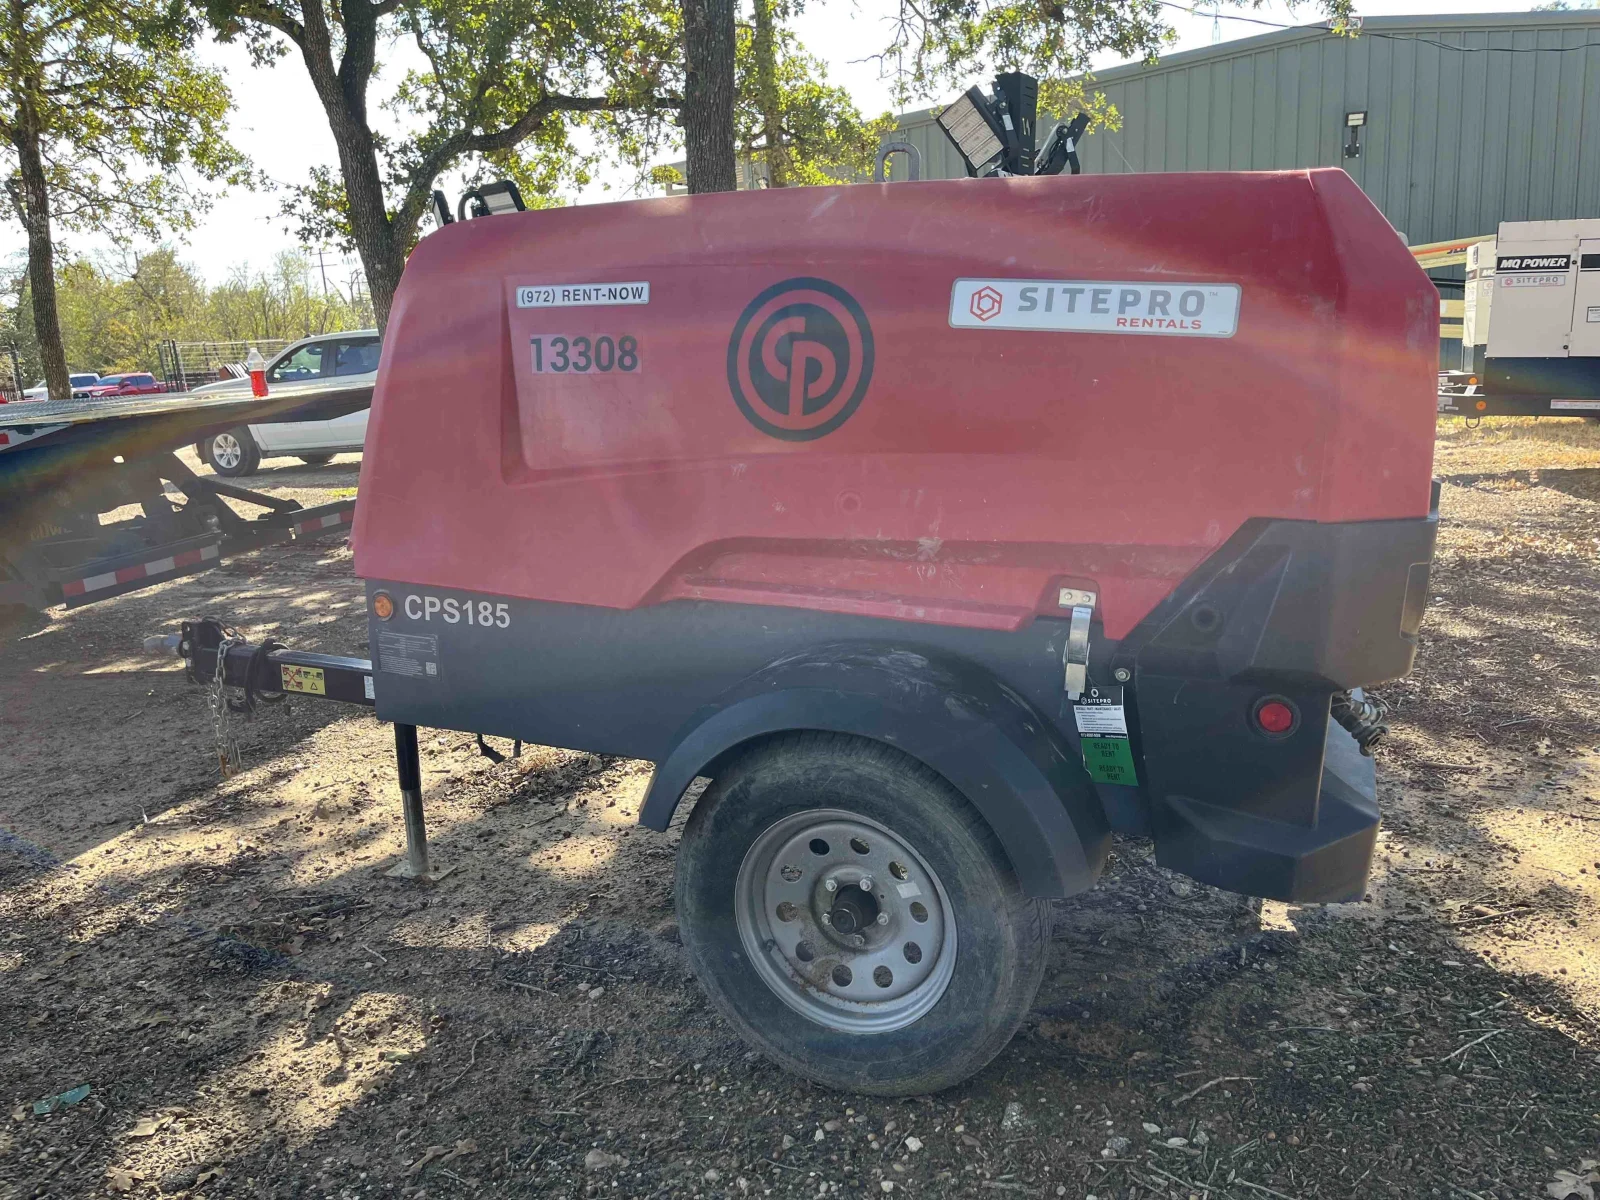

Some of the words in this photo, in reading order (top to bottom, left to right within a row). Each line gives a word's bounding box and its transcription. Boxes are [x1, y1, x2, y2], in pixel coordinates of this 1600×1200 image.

[1500, 259, 1520, 269] MQ
[1522, 257, 1568, 268] POWER
[1516, 276, 1559, 284] SITEPRO
[521, 288, 556, 305] (972)
[562, 286, 644, 302] RENT-NOW
[1018, 286, 1206, 318] SITEPRO
[1116, 317, 1203, 330] RENTALS
[530, 335, 639, 372] 13308
[404, 594, 511, 629] CPS185
